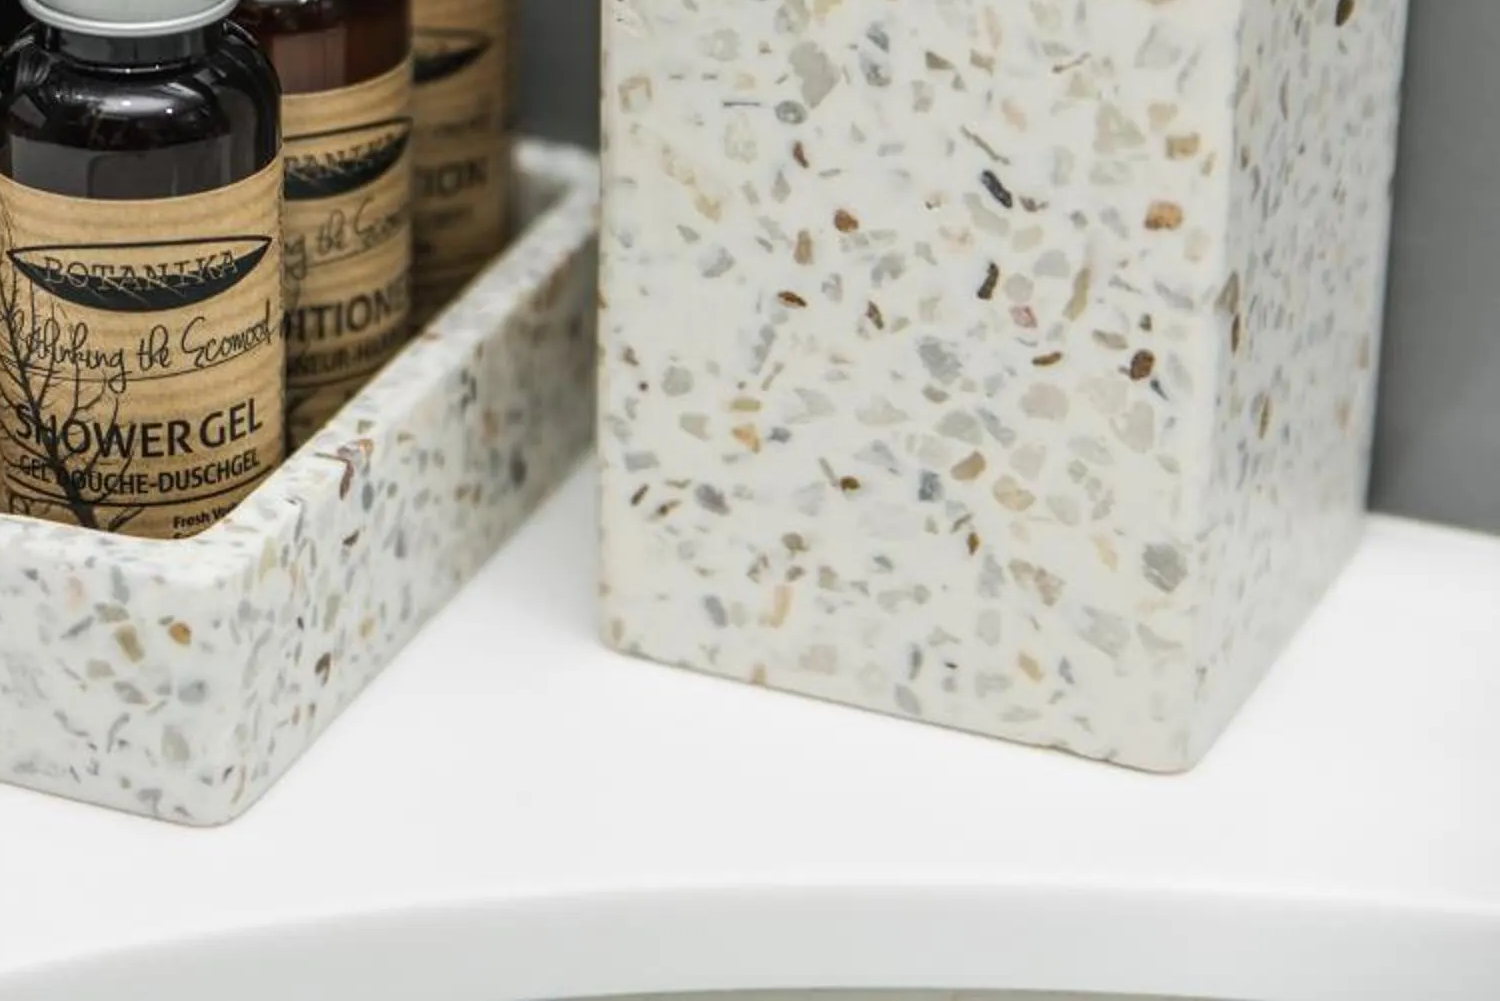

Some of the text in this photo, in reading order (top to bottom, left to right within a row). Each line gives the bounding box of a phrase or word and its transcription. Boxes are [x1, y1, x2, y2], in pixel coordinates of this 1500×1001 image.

[43, 250, 238, 291] BOTANIKA
[136, 324, 172, 370] the
[15, 398, 263, 459] SHOWER GEL
[19, 455, 51, 483] GEL
